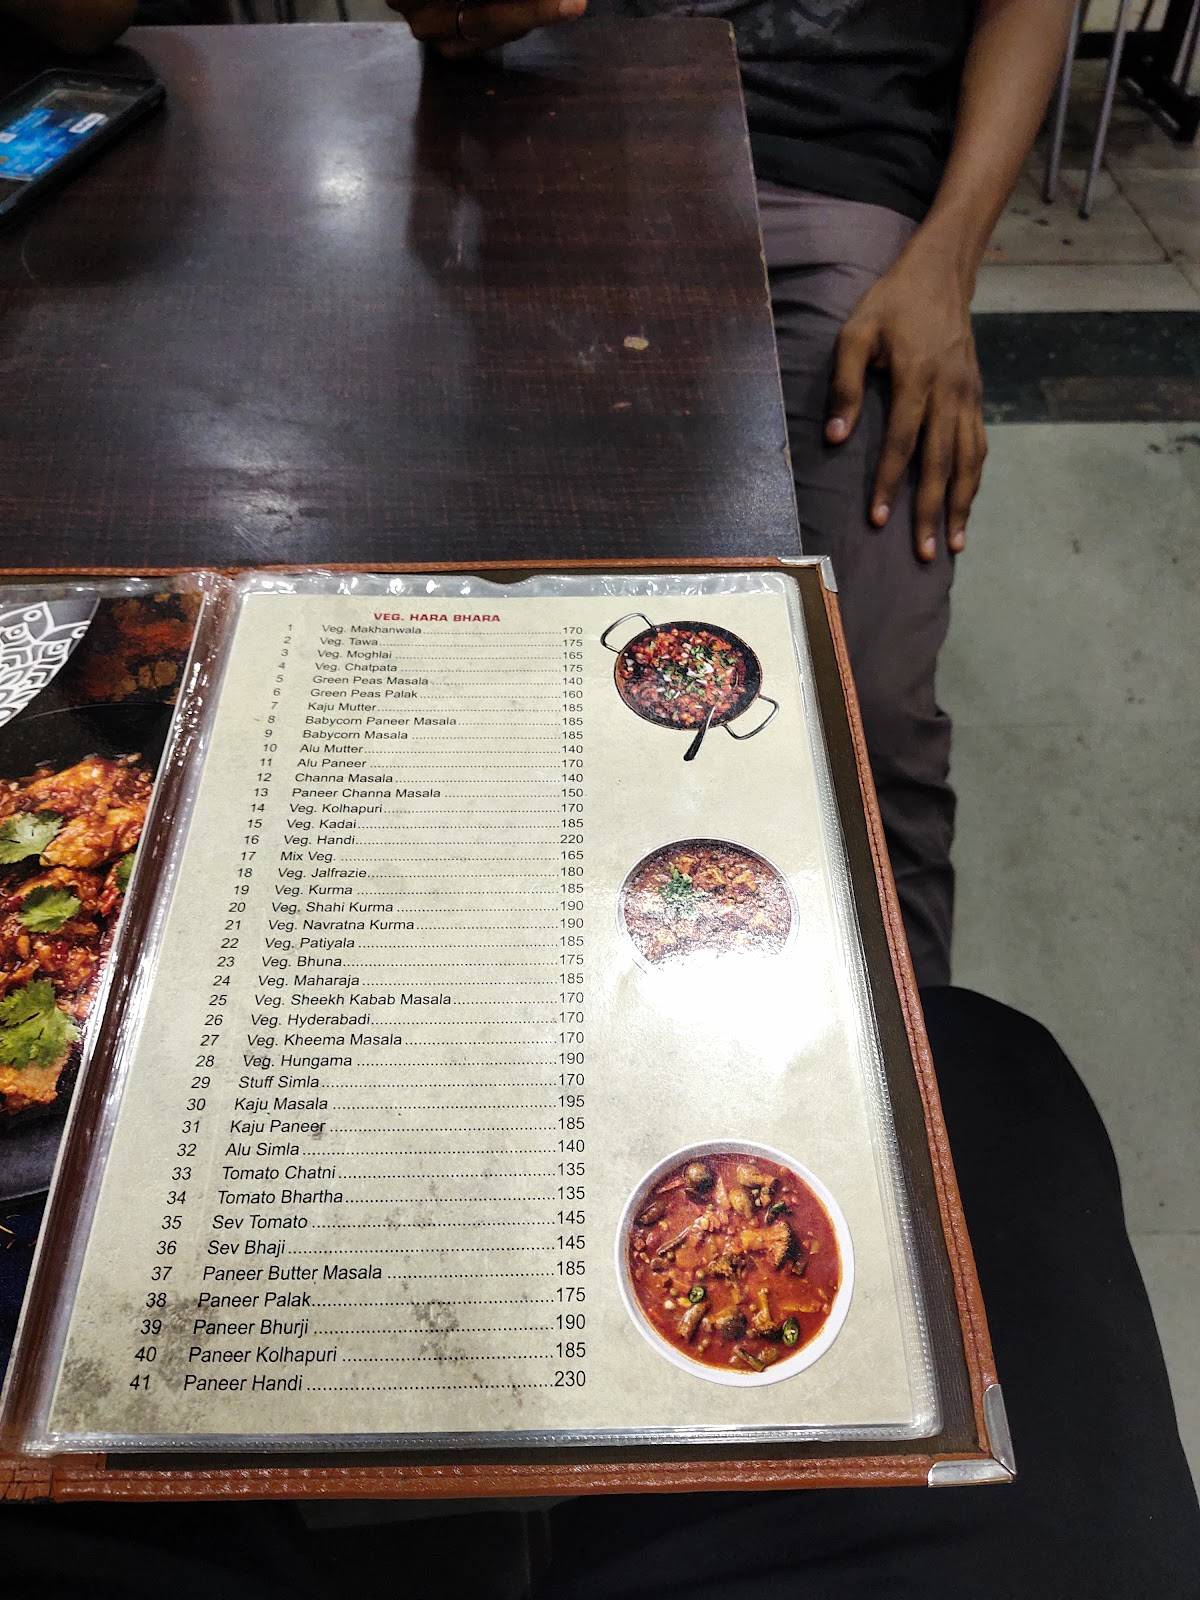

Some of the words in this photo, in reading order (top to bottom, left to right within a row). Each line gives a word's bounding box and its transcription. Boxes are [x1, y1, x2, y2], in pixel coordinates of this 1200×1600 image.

[373, 612, 405, 621] VEG.
[409, 613, 448, 622] HARA
[452, 614, 501, 623] BHARA
[321, 624, 347, 635] Veg.
[350, 625, 422, 635] Makhanwala
[563, 626, 583, 635] 170
[319, 636, 345, 648] Veg.
[348, 637, 379, 646] Tawa
[562, 638, 583, 648] 175
[316, 648, 342, 660] Veg.
[346, 649, 392, 661] Moghlai
[562, 651, 584, 660] 165
[314, 662, 340, 673] Veg.
[344, 662, 398, 674] Chatpata
[563, 663, 584, 673] 175
[312, 675, 349, 685] Green
[352, 675, 383, 685] Peas
[386, 676, 429, 686] Masala
[562, 676, 584, 686] 140
[310, 688, 347, 698] Green
[350, 688, 381, 698] Peas
[384, 689, 418, 699] Palak
[562, 689, 584, 699] 160
[307, 701, 335, 713] Kaju
[338, 702, 377, 712] Mutter
[562, 703, 584, 713] 185
[366, 716, 410, 726] Paneer
[413, 716, 457, 726] Masala
[562, 717, 584, 727] 185
[302, 729, 361, 741] Babycorn
[364, 730, 408, 740] Masala
[562, 730, 584, 740] 185
[299, 743, 320, 753] Alu
[323, 743, 364, 754] Mutter
[561, 744, 584, 754] 140
[296, 758, 318, 768] Alu
[321, 758, 367, 768] Paneer
[561, 758, 584, 768] 170
[294, 772, 344, 783] Channa
[347, 773, 393, 783] Masala
[561, 773, 584, 783] 140
[291, 787, 339, 798] Paneer
[341, 788, 392, 798] Channa
[395, 788, 441, 799] Masala
[561, 788, 584, 798] 150
[289, 802, 317, 816] Veg.
[321, 803, 383, 816] Kolhapuri
[561, 803, 584, 813] 170
[286, 818, 315, 832] Veg.
[319, 819, 357, 829] Kadai
[561, 818, 584, 829] 185
[283, 834, 313, 847] Veg.
[316, 834, 356, 845] Handi
[559, 833, 584, 844] 220
[280, 851, 304, 861] Mix
[308, 850, 338, 864] Veg.
[561, 850, 584, 861] 165
[278, 867, 307, 881] Veg.
[310, 867, 367, 878] Jalfrazie
[560, 866, 584, 877] 180
[274, 884, 304, 898] Veg.
[308, 884, 353, 895] Kurma
[560, 883, 584, 894] 185
[271, 901, 301, 916] Veg.
[305, 901, 345, 913] Shahi
[348, 901, 394, 913] Kurma
[560, 900, 584, 911] 190
[268, 919, 298, 933] Veg.
[302, 919, 365, 930] Navratna
[369, 919, 415, 930] Kurma
[560, 917, 584, 929] 190
[264, 937, 295, 952] Veg.
[299, 937, 355, 951] Patiyala
[559, 935, 585, 947] 185
[261, 956, 292, 970] Veg.
[296, 955, 343, 967] Bhuna
[559, 953, 584, 965] 175
[258, 975, 289, 989] Veg.
[293, 974, 360, 989] Maharaja
[559, 972, 584, 985] 185
[254, 994, 286, 1009] Veg.
[290, 993, 345, 1006] Sheekh
[349, 993, 396, 1006] Kabab
[400, 993, 452, 1005] Masala
[559, 991, 585, 1004] 170
[251, 1013, 282, 1029] Veg.
[287, 1013, 371, 1029] Hyderabadi
[559, 1011, 585, 1024] 170
[247, 1033, 279, 1050] Veg.
[283, 1033, 345, 1046] Kheema
[350, 1033, 402, 1046] Masala
[559, 1031, 585, 1044] 170
[195, 1054, 215, 1068] 28
[243, 1054, 276, 1071] Veg.
[280, 1054, 352, 1070] Hungama
[558, 1051, 585, 1065] 190
[190, 1076, 211, 1089] 29
[238, 1075, 275, 1089] Stuff
[277, 1075, 320, 1089] Simla
[559, 1073, 585, 1086] 170
[186, 1097, 206, 1111] 30
[234, 1097, 269, 1114] Kaju
[273, 1096, 328, 1111] Masala
[558, 1094, 585, 1108] 195
[181, 1119, 200, 1134] 31
[229, 1119, 265, 1137] Kaju
[269, 1119, 327, 1133] Paneer
[558, 1116, 585, 1130] 185
[176, 1143, 197, 1157] 32
[224, 1142, 251, 1157] Alu
[255, 1142, 300, 1156] Simla
[558, 1139, 585, 1153] 140
[171, 1166, 192, 1181] 33
[222, 1166, 280, 1181] Tomato
[284, 1164, 337, 1180] Chatni
[557, 1162, 586, 1176] 135
[166, 1190, 186, 1205] 34
[217, 1190, 276, 1205] Tomato
[281, 1189, 344, 1204] Bhartha
[557, 1185, 585, 1200] 135
[161, 1215, 183, 1230] 35
[212, 1214, 245, 1230] Sev
[249, 1214, 308, 1229] Tomato
[557, 1210, 586, 1225] 145
[156, 1240, 178, 1255] 36
[207, 1239, 240, 1255] Sev
[244, 1239, 286, 1258] Bhaji
[556, 1234, 586, 1250] 145
[150, 1265, 173, 1281] 37
[202, 1265, 265, 1281] Paneer
[267, 1265, 319, 1281] Butter
[322, 1263, 382, 1280] Masala
[556, 1260, 586, 1276] 185
[145, 1292, 167, 1309] 38
[197, 1292, 260, 1308] Paneer
[263, 1291, 311, 1308] Palak
[556, 1286, 586, 1303] 175
[140, 1318, 162, 1336] 39
[192, 1319, 256, 1335] Paneer
[259, 1318, 309, 1339] Bhurji
[556, 1313, 586, 1330] 190
[134, 1346, 157, 1363] 40
[188, 1346, 252, 1363] Paneer
[256, 1345, 338, 1367] Kolhapuri
[555, 1341, 586, 1359] 185
[129, 1373, 151, 1391] 41
[183, 1374, 248, 1391] Paneer
[251, 1374, 303, 1392] Handi
[554, 1370, 586, 1387] 230
